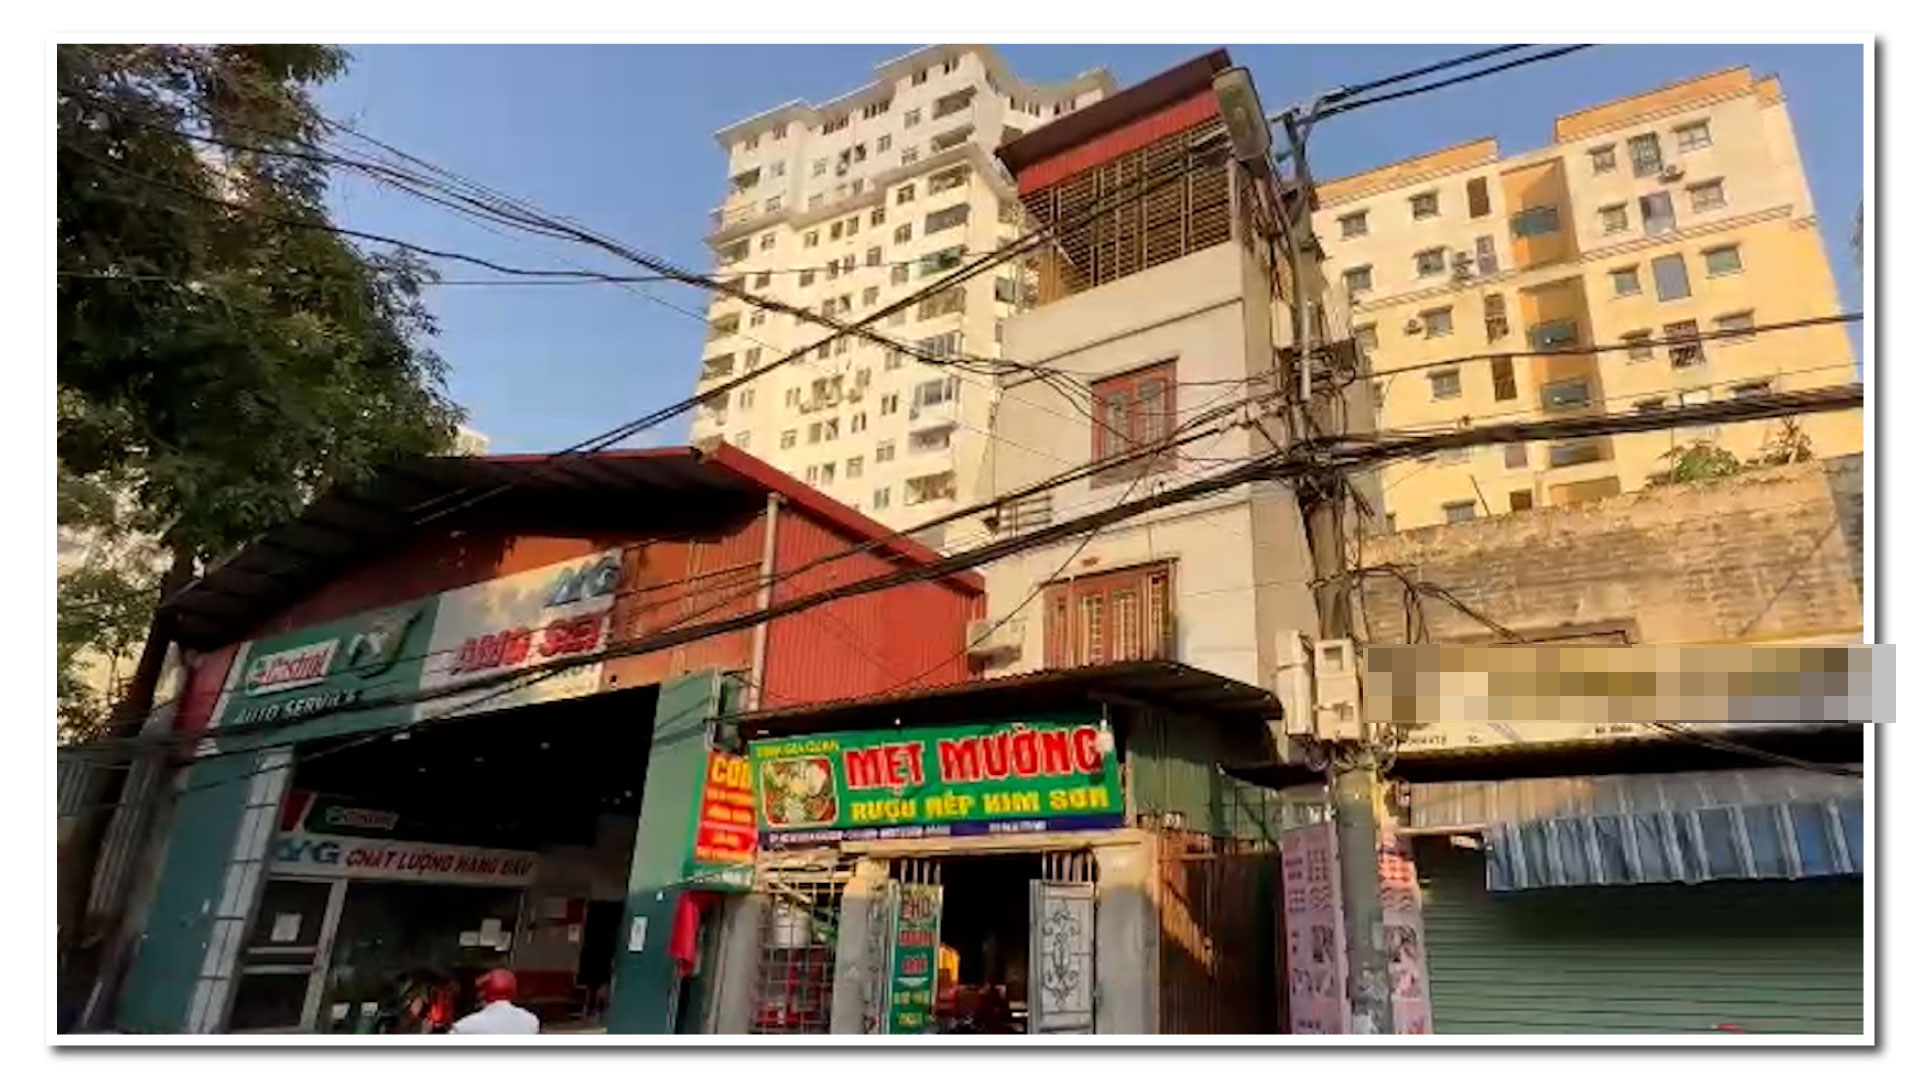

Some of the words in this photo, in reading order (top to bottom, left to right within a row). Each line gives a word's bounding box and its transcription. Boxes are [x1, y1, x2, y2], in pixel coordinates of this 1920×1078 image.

[844, 741, 926, 797] MẸT
[937, 723, 1104, 783] MƯỜNG
[984, 790, 1040, 814] KIM
